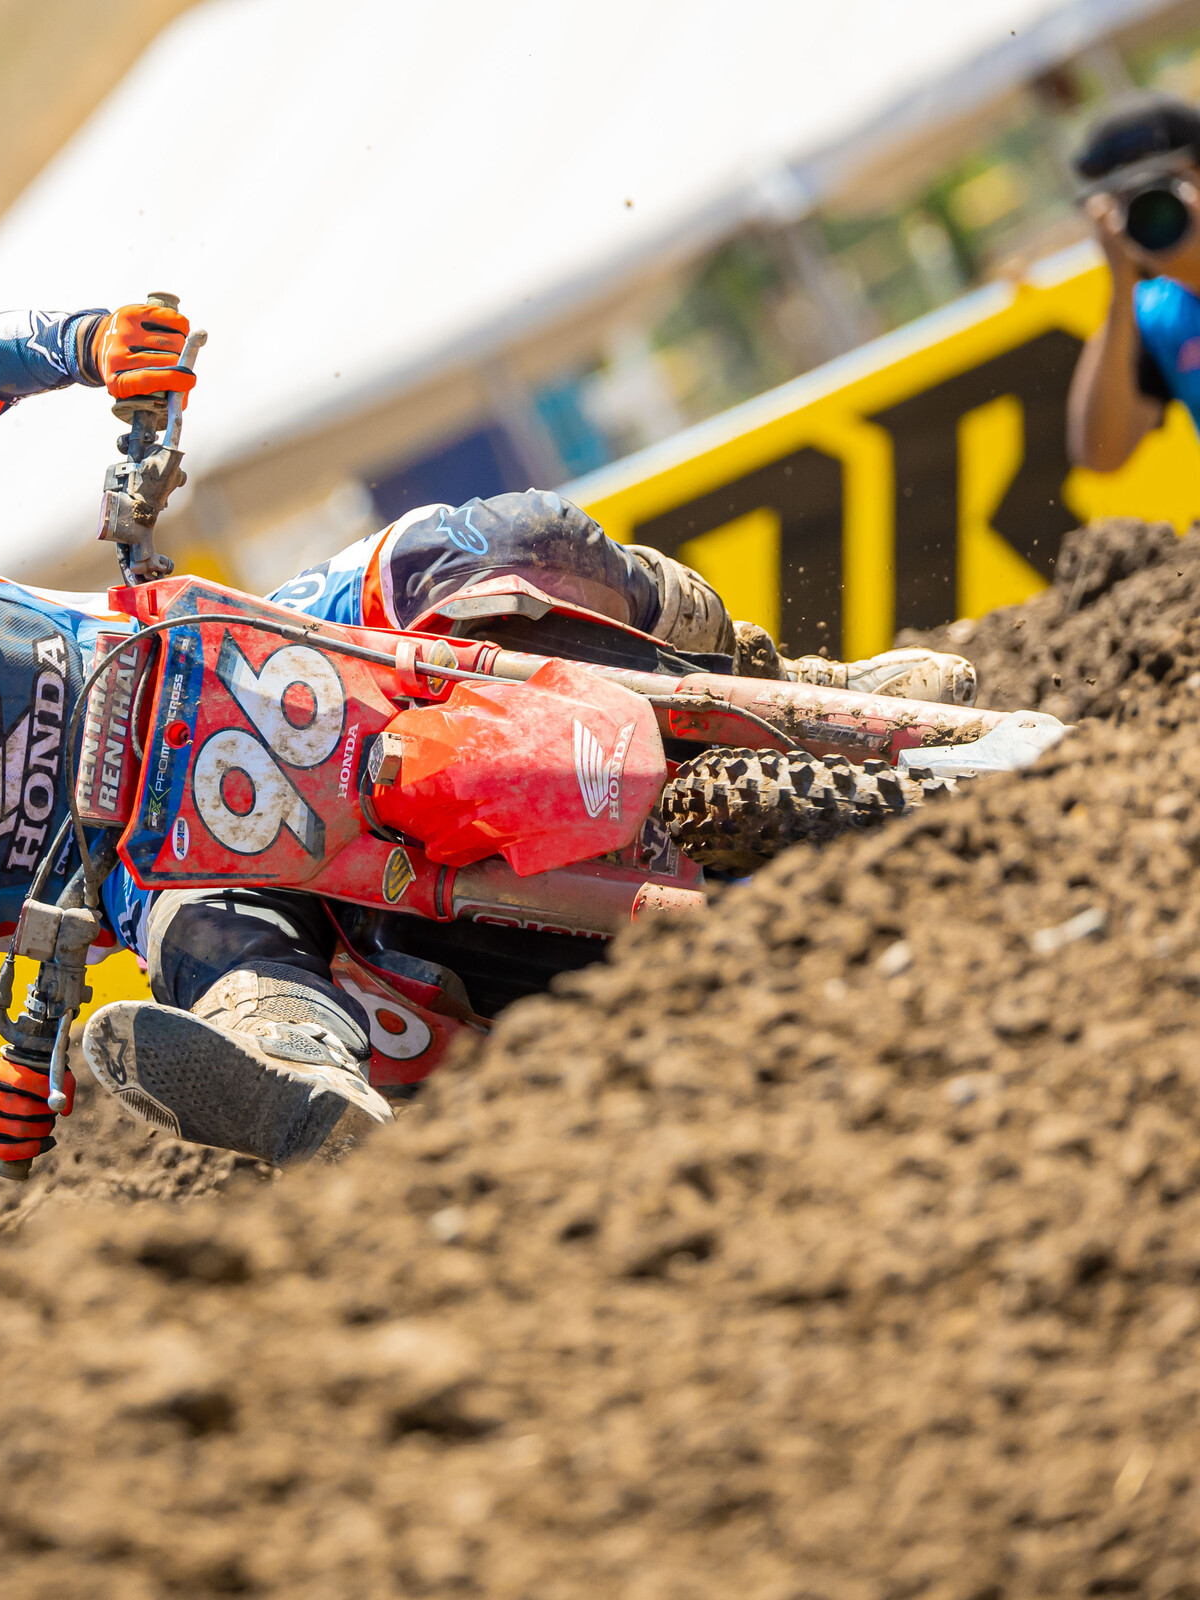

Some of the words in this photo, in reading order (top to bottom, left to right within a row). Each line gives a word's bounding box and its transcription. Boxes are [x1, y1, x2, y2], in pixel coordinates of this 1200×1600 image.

[6, 635, 67, 872] HONDA
[98, 646, 139, 812] RENTHAL
[192, 628, 348, 858] 96
[337, 723, 359, 799] HONDA
[609, 722, 634, 820] HONDA
